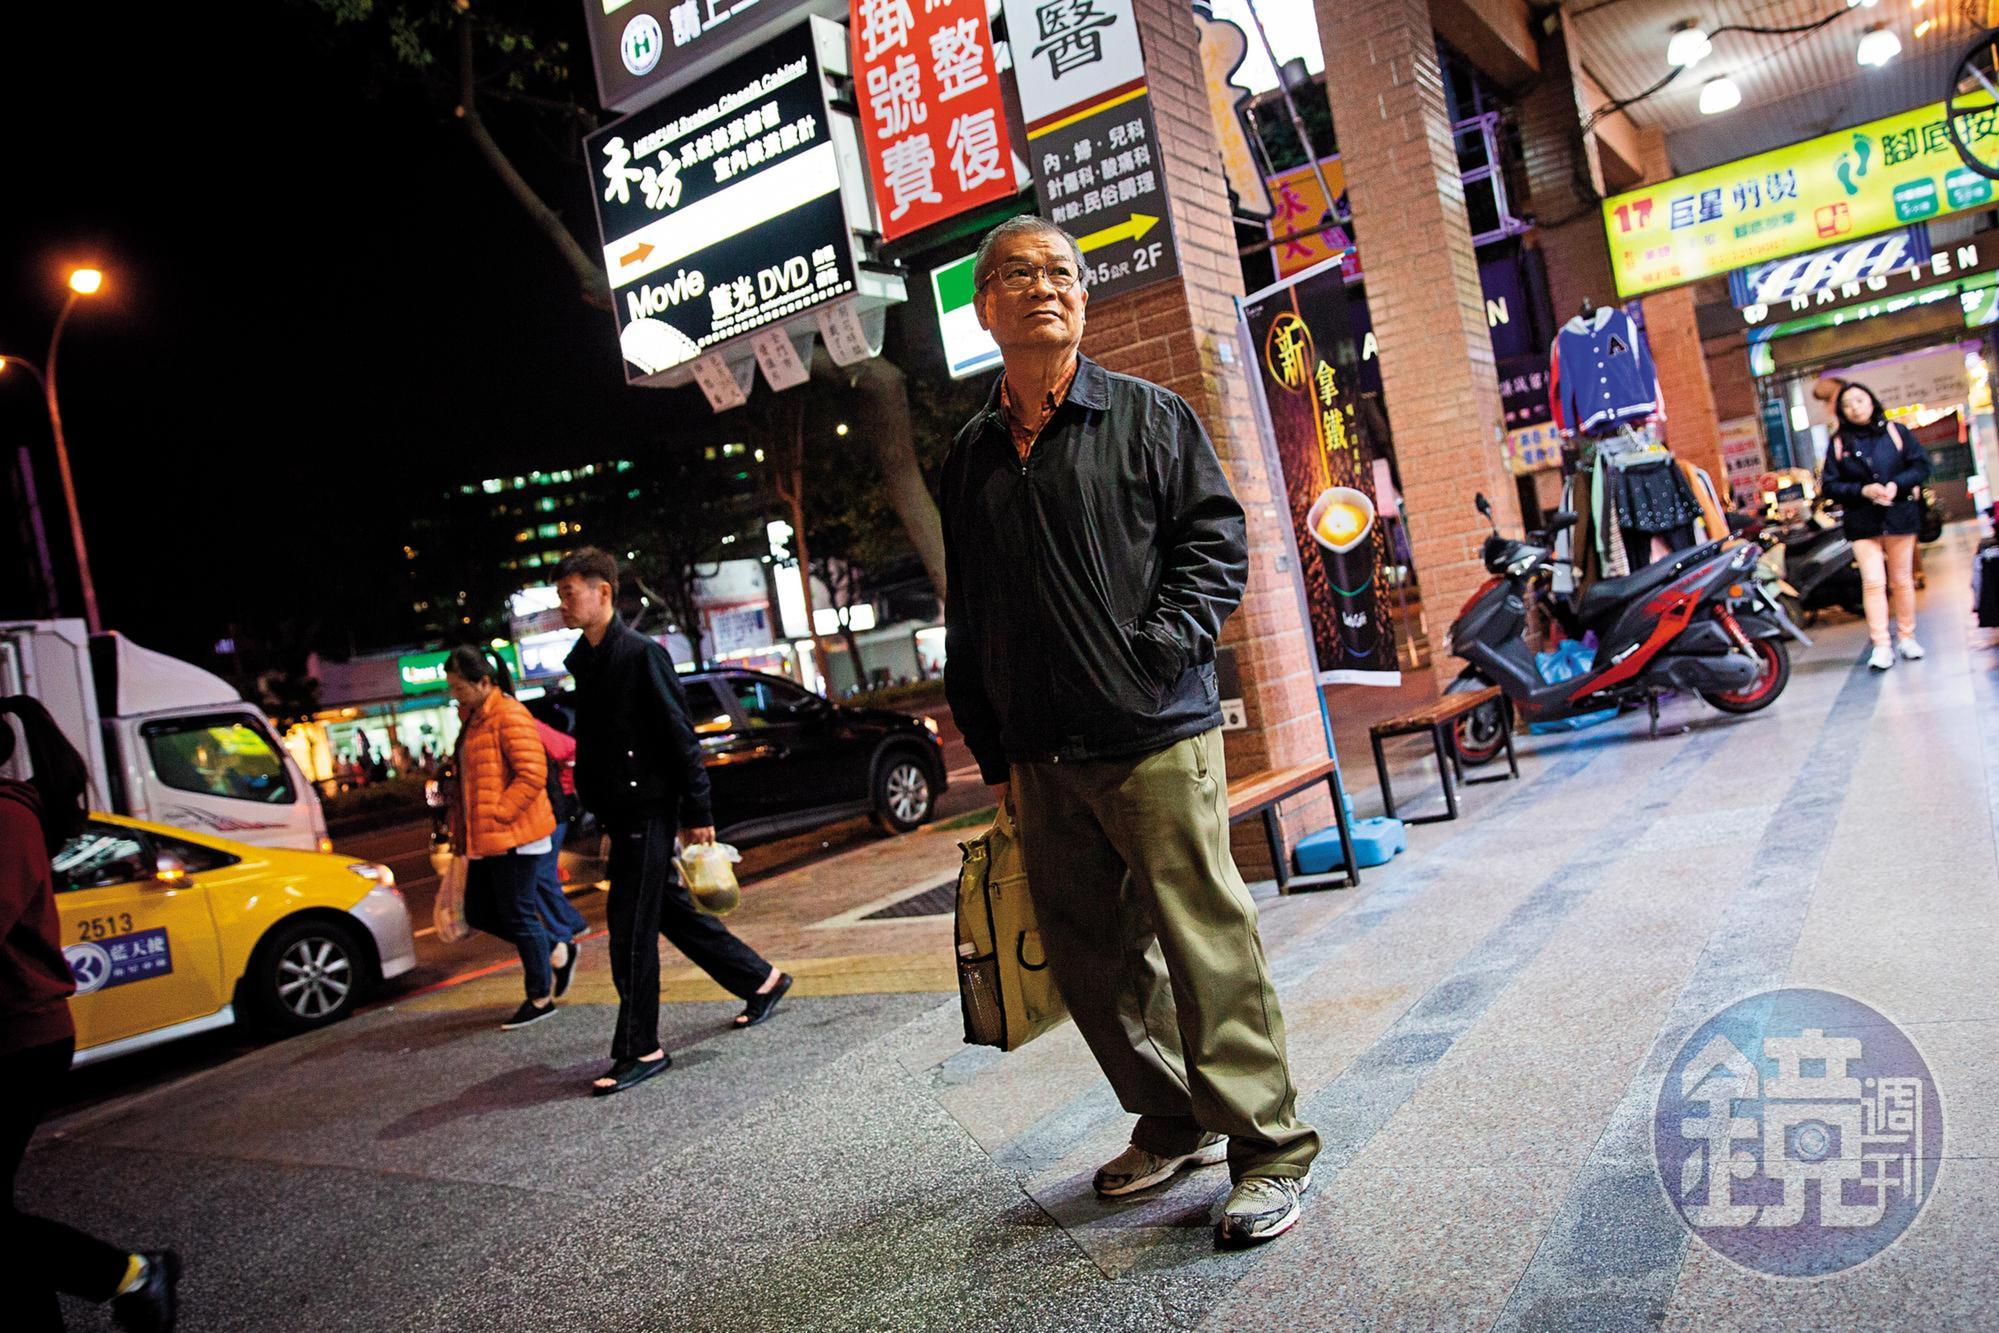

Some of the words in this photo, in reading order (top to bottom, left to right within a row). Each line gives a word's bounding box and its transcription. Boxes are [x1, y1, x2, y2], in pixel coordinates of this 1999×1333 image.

[1032, 0, 1117, 80] 醫
[859, 0, 943, 221] 掛號費
[925, 0, 1006, 192] 整復
[1613, 198, 1653, 233] 17
[757, 255, 810, 301] DVD
[1133, 242, 1163, 272] 2F
[626, 268, 705, 322] Movie
[1607, 333, 1626, 356] A
[1274, 319, 1305, 387] 新
[1315, 359, 1349, 451] 拿鐵
[78, 912, 133, 941] 2513
